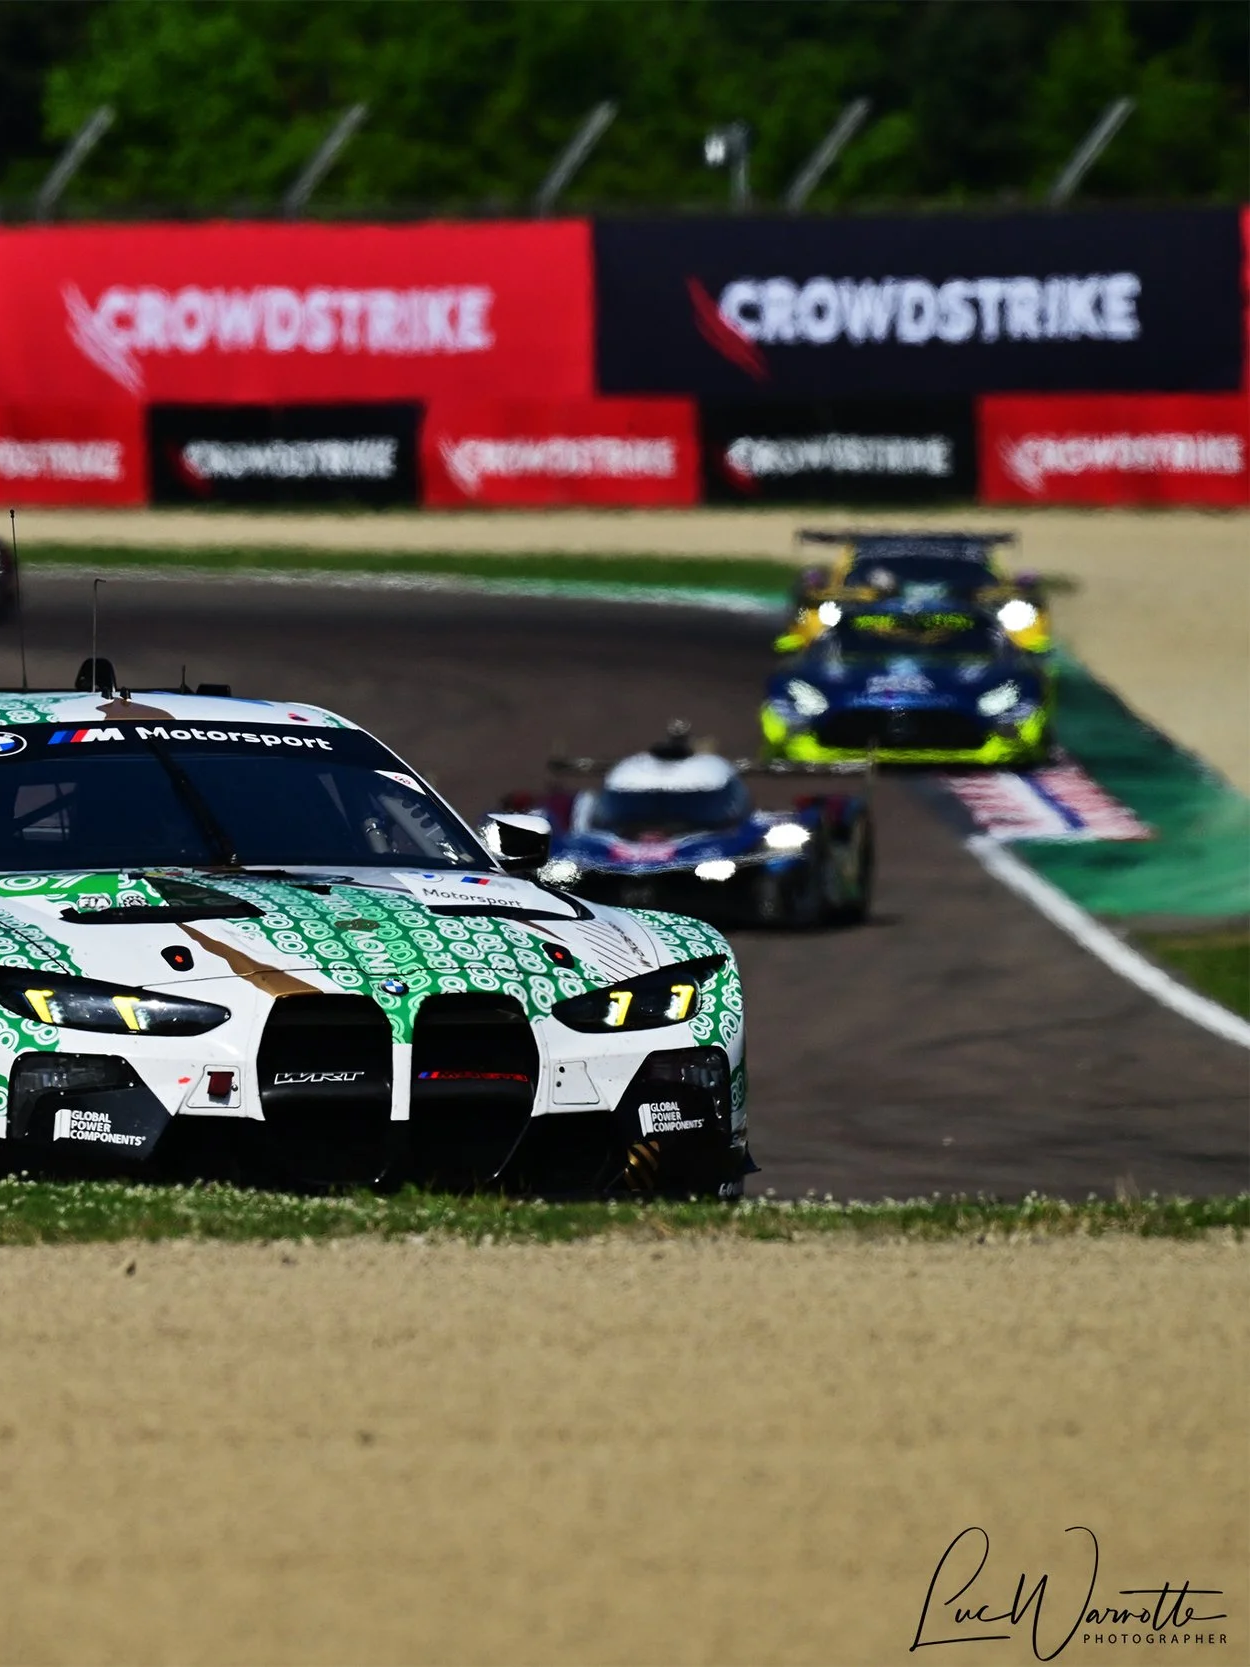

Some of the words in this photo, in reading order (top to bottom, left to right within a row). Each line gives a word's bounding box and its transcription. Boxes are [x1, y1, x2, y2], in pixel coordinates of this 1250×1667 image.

[719, 272, 1141, 344] CROWDSTRIKE
[95, 285, 494, 354] CROWDSTRIKE
[135, 727, 333, 750] Motorsport
[422, 886, 522, 908] Motorsport
[274, 1071, 364, 1084] WRT
[650, 1102, 680, 1112] GLOBAL
[72, 1110, 111, 1123] GLOBAL
[652, 1112, 681, 1122] POWER
[71, 1119, 111, 1132] POWER
[653, 1119, 703, 1132] COMPONENTS
[70, 1130, 144, 1146] COMPONENTS
